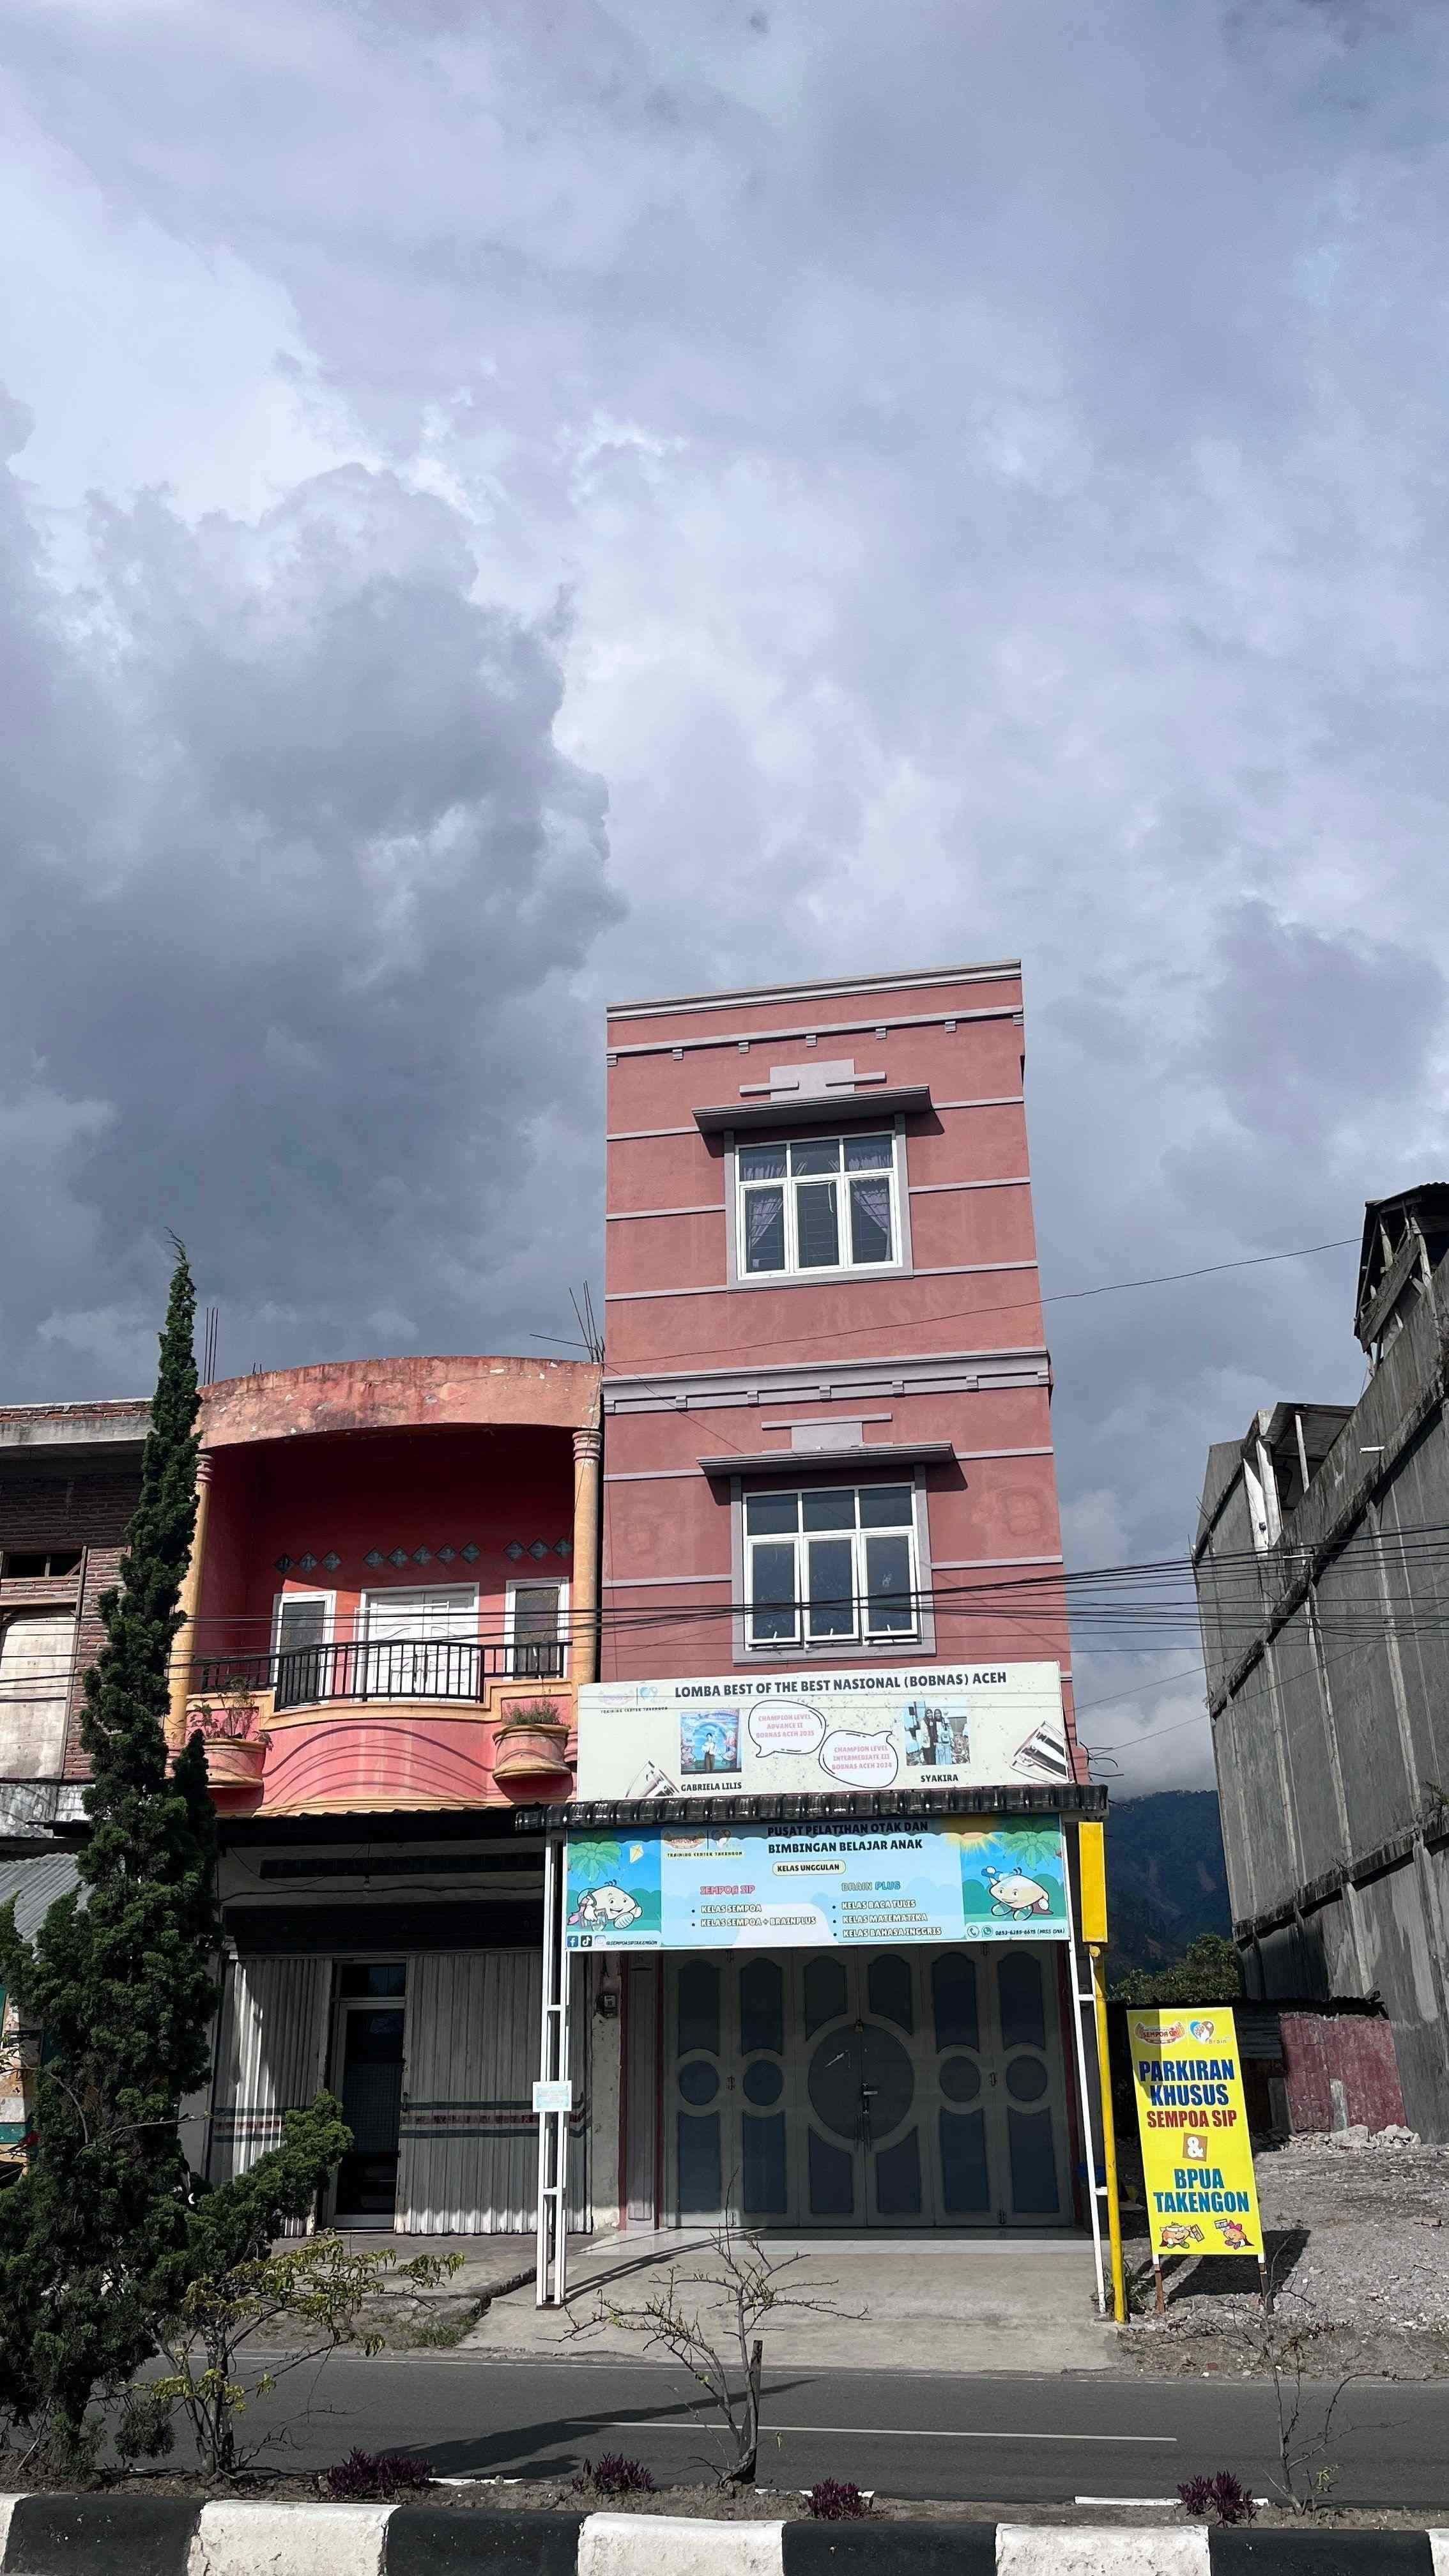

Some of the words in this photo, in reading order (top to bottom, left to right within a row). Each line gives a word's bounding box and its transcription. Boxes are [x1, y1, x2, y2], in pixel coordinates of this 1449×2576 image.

[675, 1685, 721, 1698] LOMBA
[724, 1683, 753, 1696] BEST
[756, 1682, 772, 1694] OF
[774, 1681, 798, 1693] THE
[801, 1680, 831, 1692] BEST
[833, 1676, 901, 1690] NASIONAL
[904, 1673, 969, 1688] (BOBNAS)
[972, 1671, 1007, 1684] ACEH
[920, 1774, 959, 1782] SYAKIRA
[681, 1782, 720, 1791] GABRIELA
[722, 1782, 742, 1790] LILIS
[767, 1825, 804, 1837] PUSAT
[806, 1823, 869, 1836] PELATIHAN
[870, 1821, 901, 1834] OTAK
[904, 1821, 928, 1832] DAN
[768, 1841, 837, 1854] BIMBINGAN
[839, 1840, 888, 1851] BELAJAR
[890, 1839, 923, 1850] ANAK
[800, 1863, 840, 1871] UNGGULAN
[700, 1885, 739, 1896] SEMPOA
[740, 1885, 756, 1894] SIP
[841, 1882, 873, 1892] BRAIN
[875, 1881, 901, 1890] PLUS
[701, 1905, 726, 1913] KELAS
[726, 1904, 762, 1913] SEMPOA
[841, 1901, 868, 1910] KELAS
[868, 1900, 893, 1909] BACA
[891, 1899, 916, 1908] TULIS
[700, 1919, 726, 1927] KELAS
[727, 1917, 762, 1926] SEMPOA
[769, 1916, 816, 1926] BRAINPLUS
[842, 1915, 868, 1924] KELAS
[869, 1913, 928, 1923] MATEMATIKA
[843, 1929, 869, 1938] KELAS
[870, 1928, 906, 1936] BAHASA
[906, 1927, 942, 1936] INGGRIS
[1138, 2058, 1235, 2082] PARKIRAN
[1150, 2083, 1229, 2106] KHUSUS
[1146, 2110, 1209, 2128] SEMPOA
[1212, 2110, 1238, 2128] SIP
[1186, 2136, 1204, 2159] &
[1174, 2168, 1225, 2189] BPUA
[1153, 2191, 1250, 2213] TAKENGON
